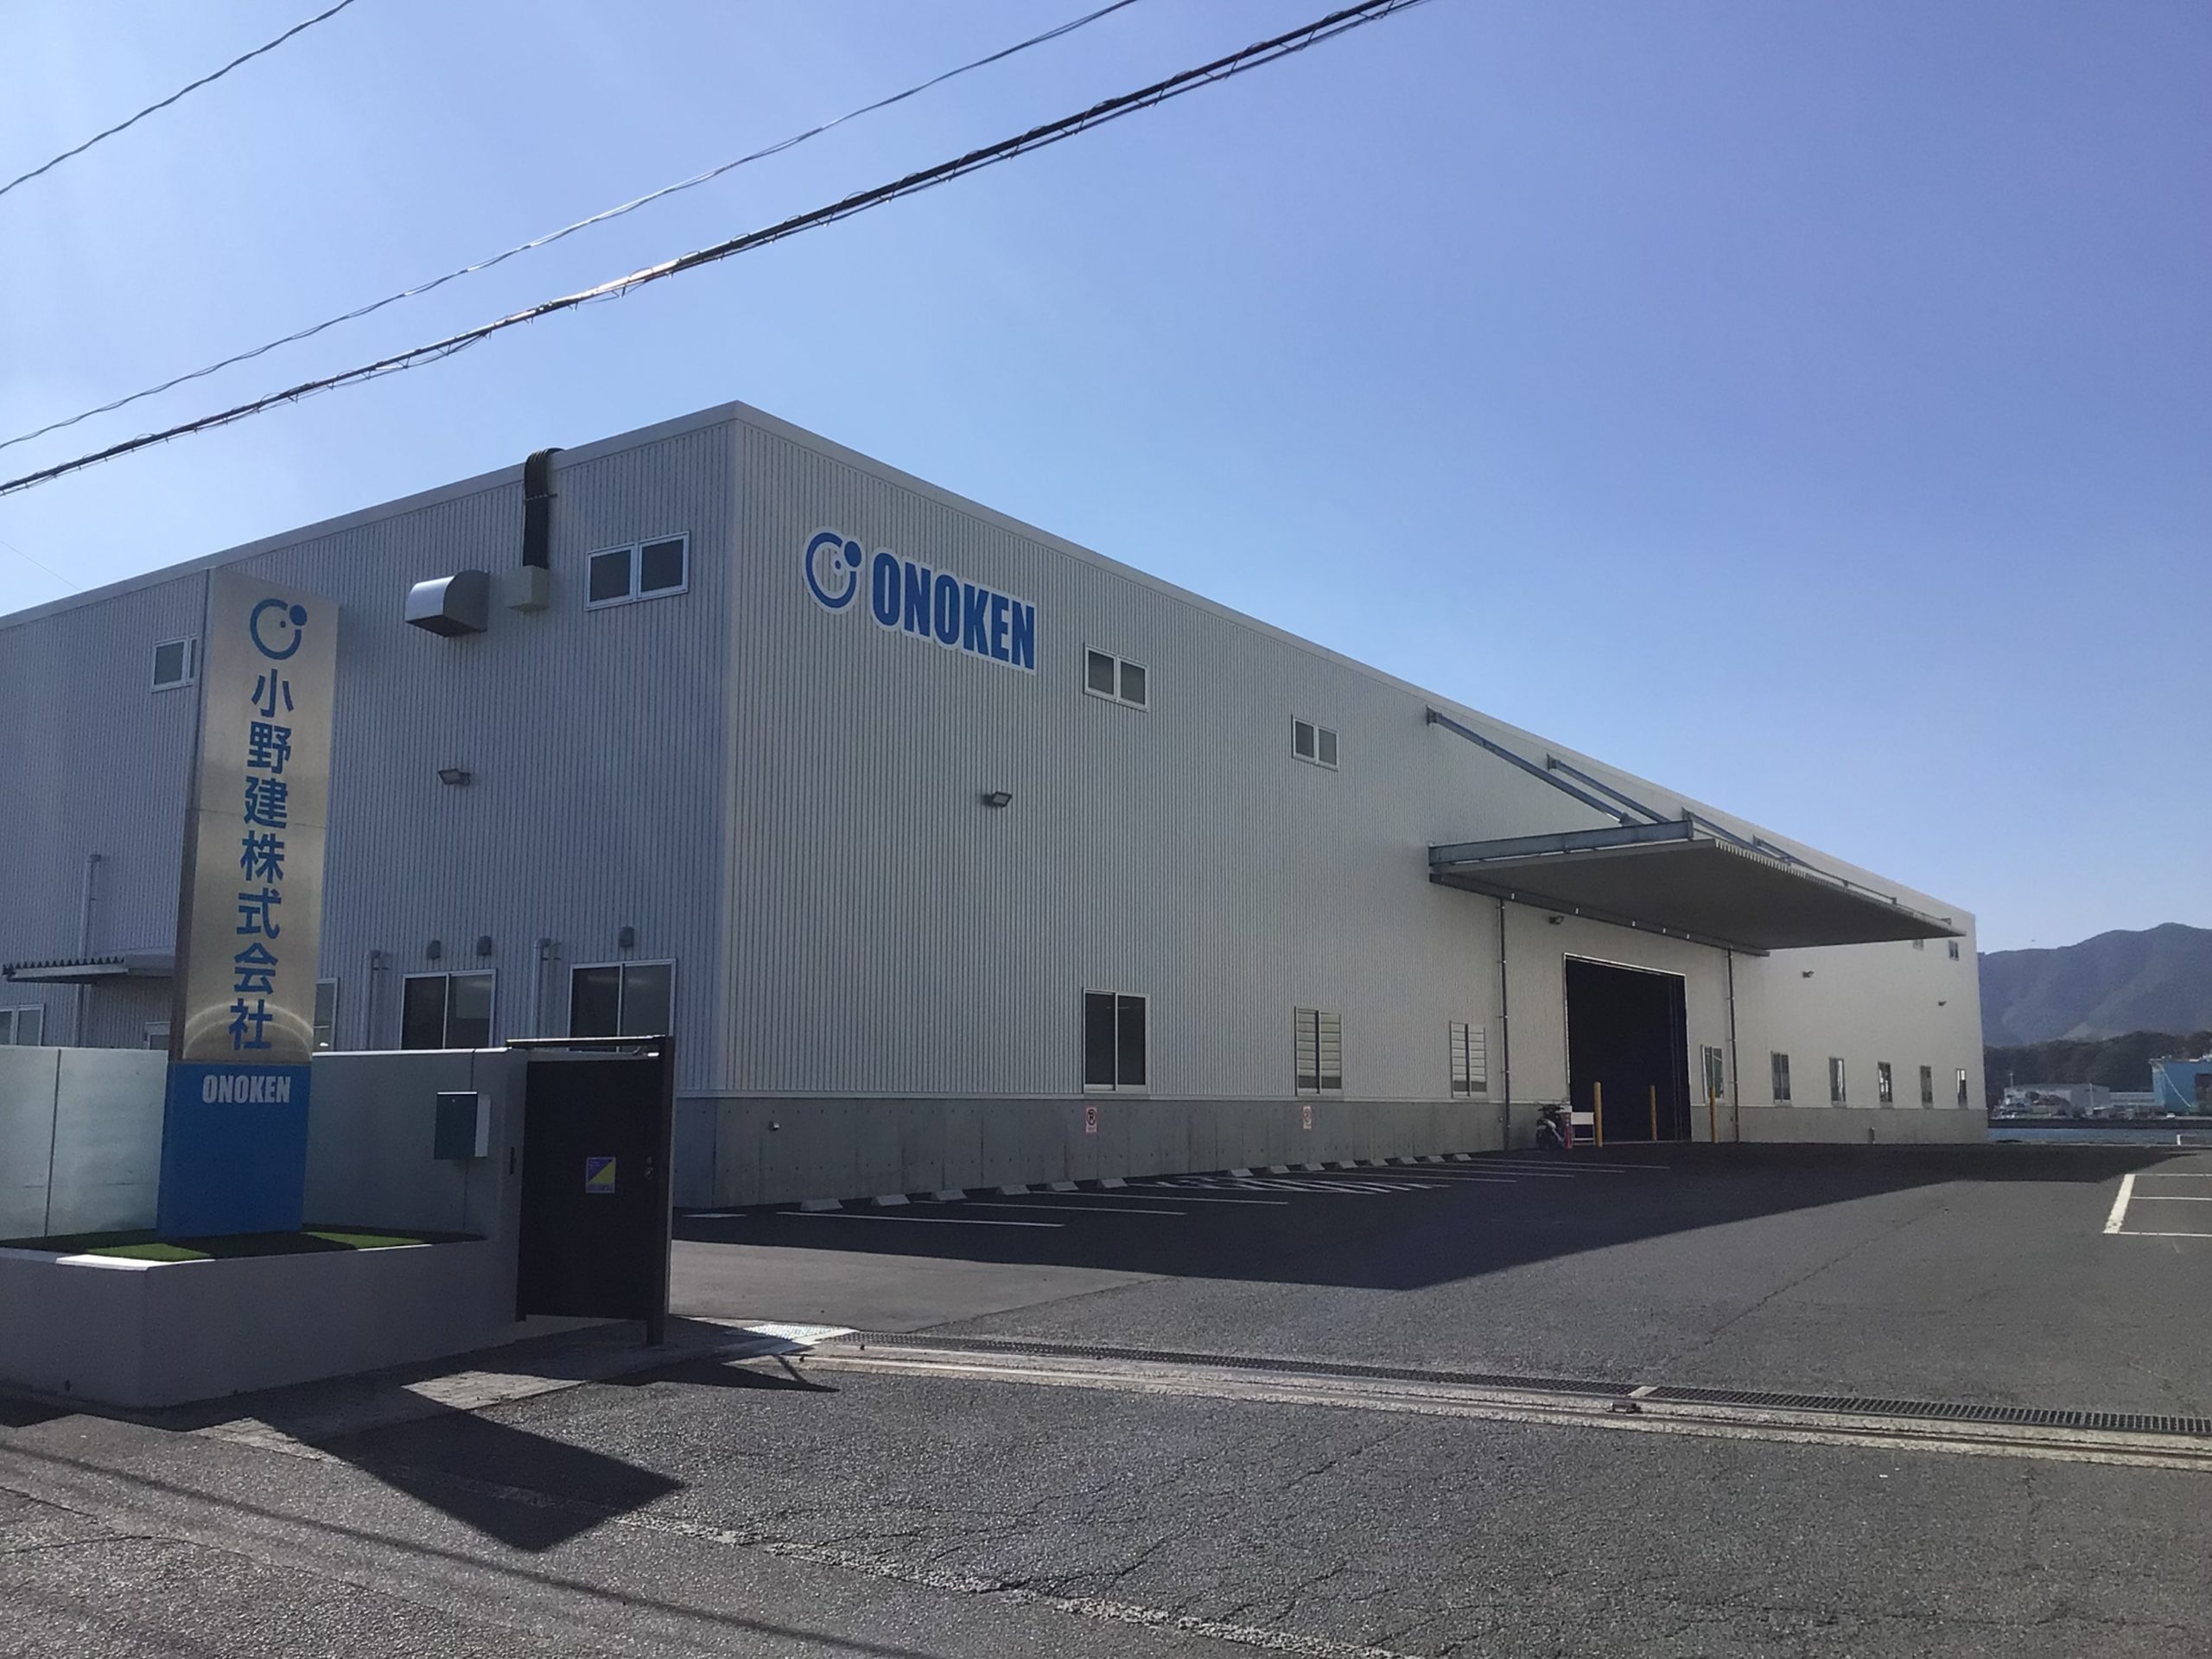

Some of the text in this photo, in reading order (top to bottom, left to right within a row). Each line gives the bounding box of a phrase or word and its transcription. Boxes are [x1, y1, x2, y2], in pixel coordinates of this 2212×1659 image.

[873, 552, 1035, 671] ONOKEN
[228, 668, 295, 1050] 小野建株式会社
[201, 1075, 291, 1104] ONOKEN
